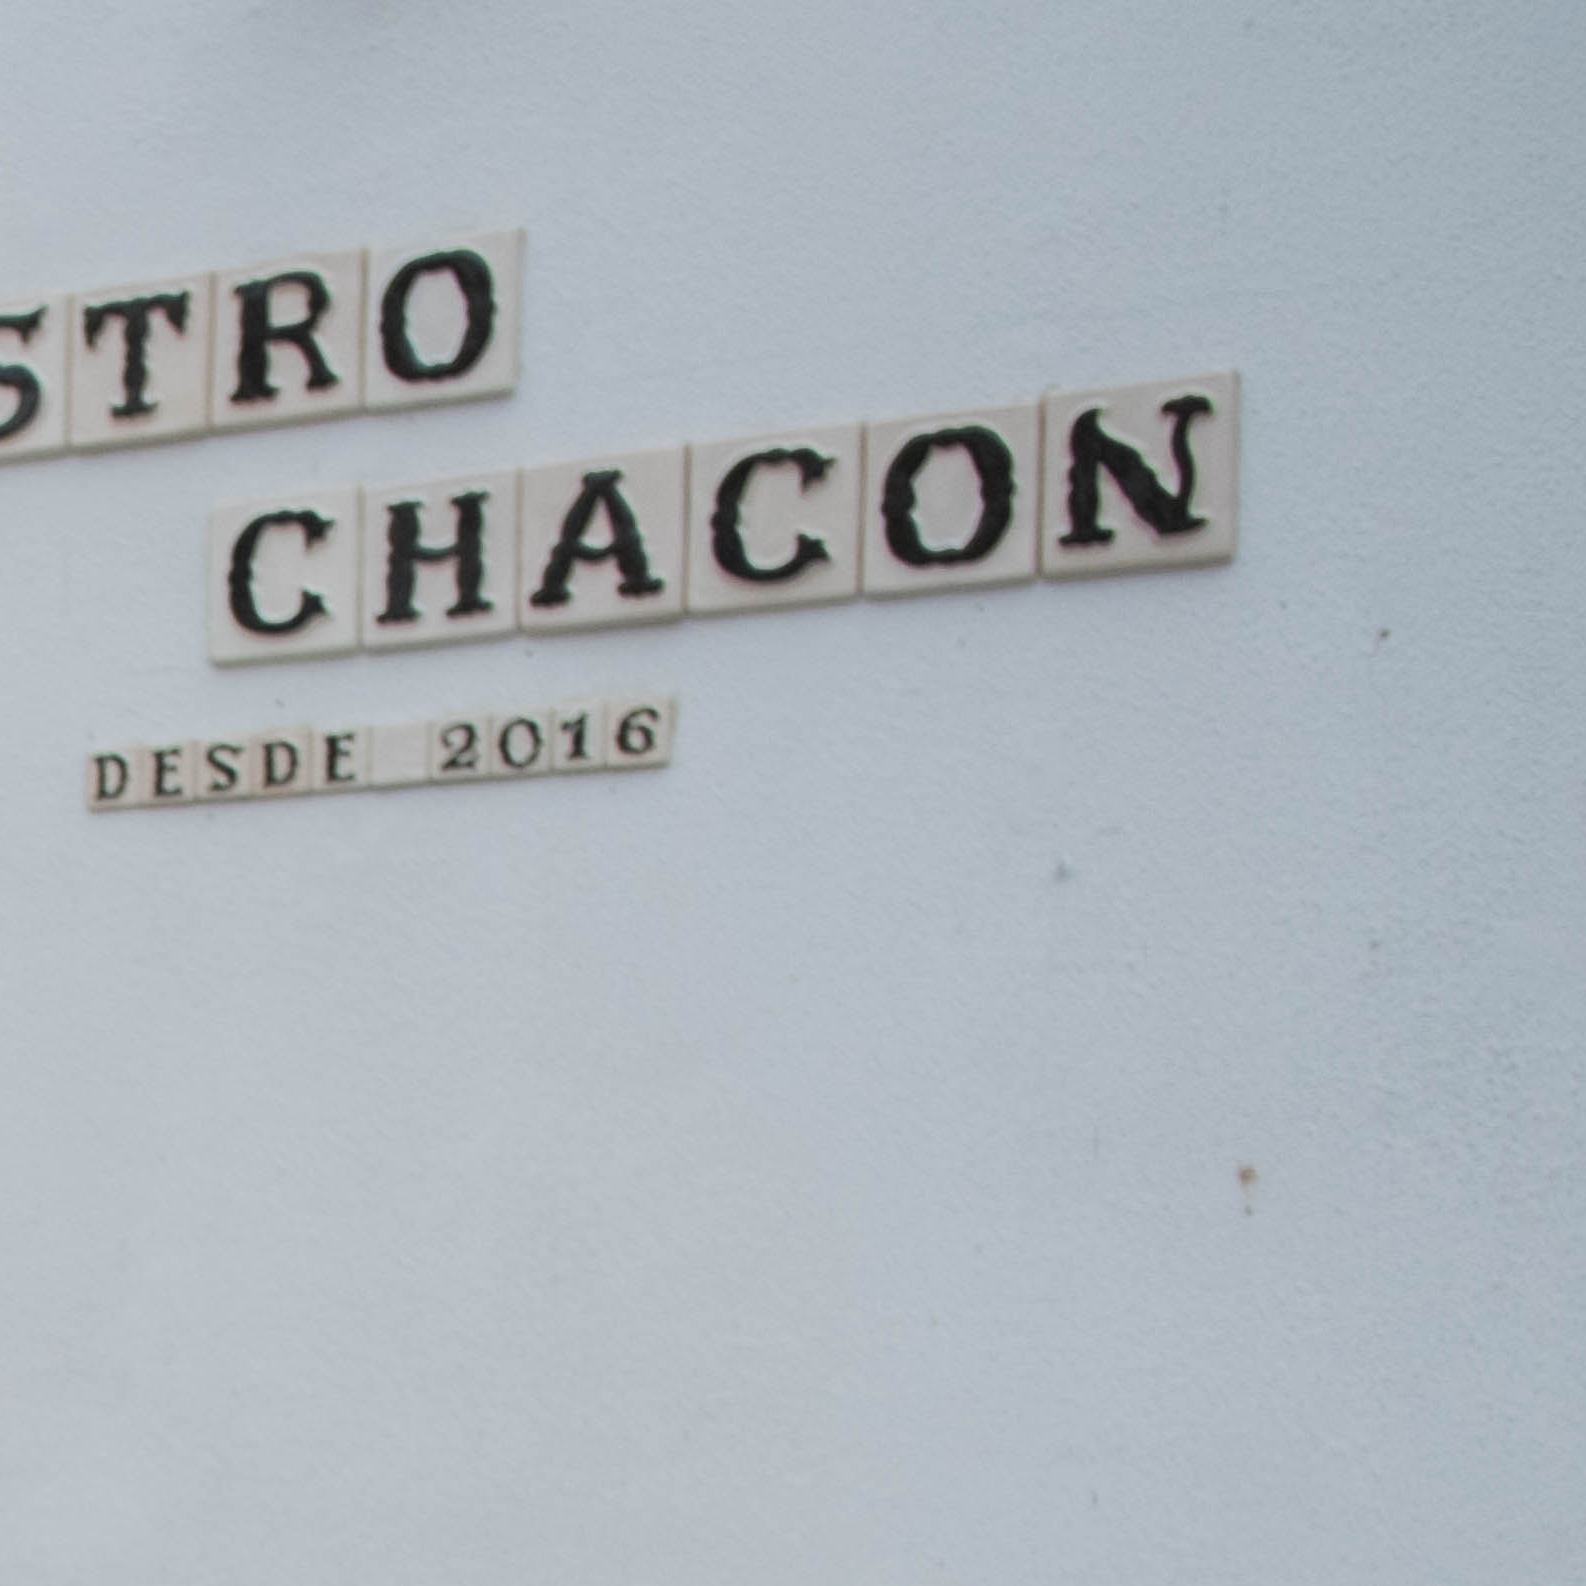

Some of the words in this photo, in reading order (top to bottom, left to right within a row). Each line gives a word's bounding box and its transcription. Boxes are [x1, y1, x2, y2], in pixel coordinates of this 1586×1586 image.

[226, 393, 1215, 639] CHACON
[93, 732, 357, 803] DESDE
[440, 706, 660, 774] 2016
